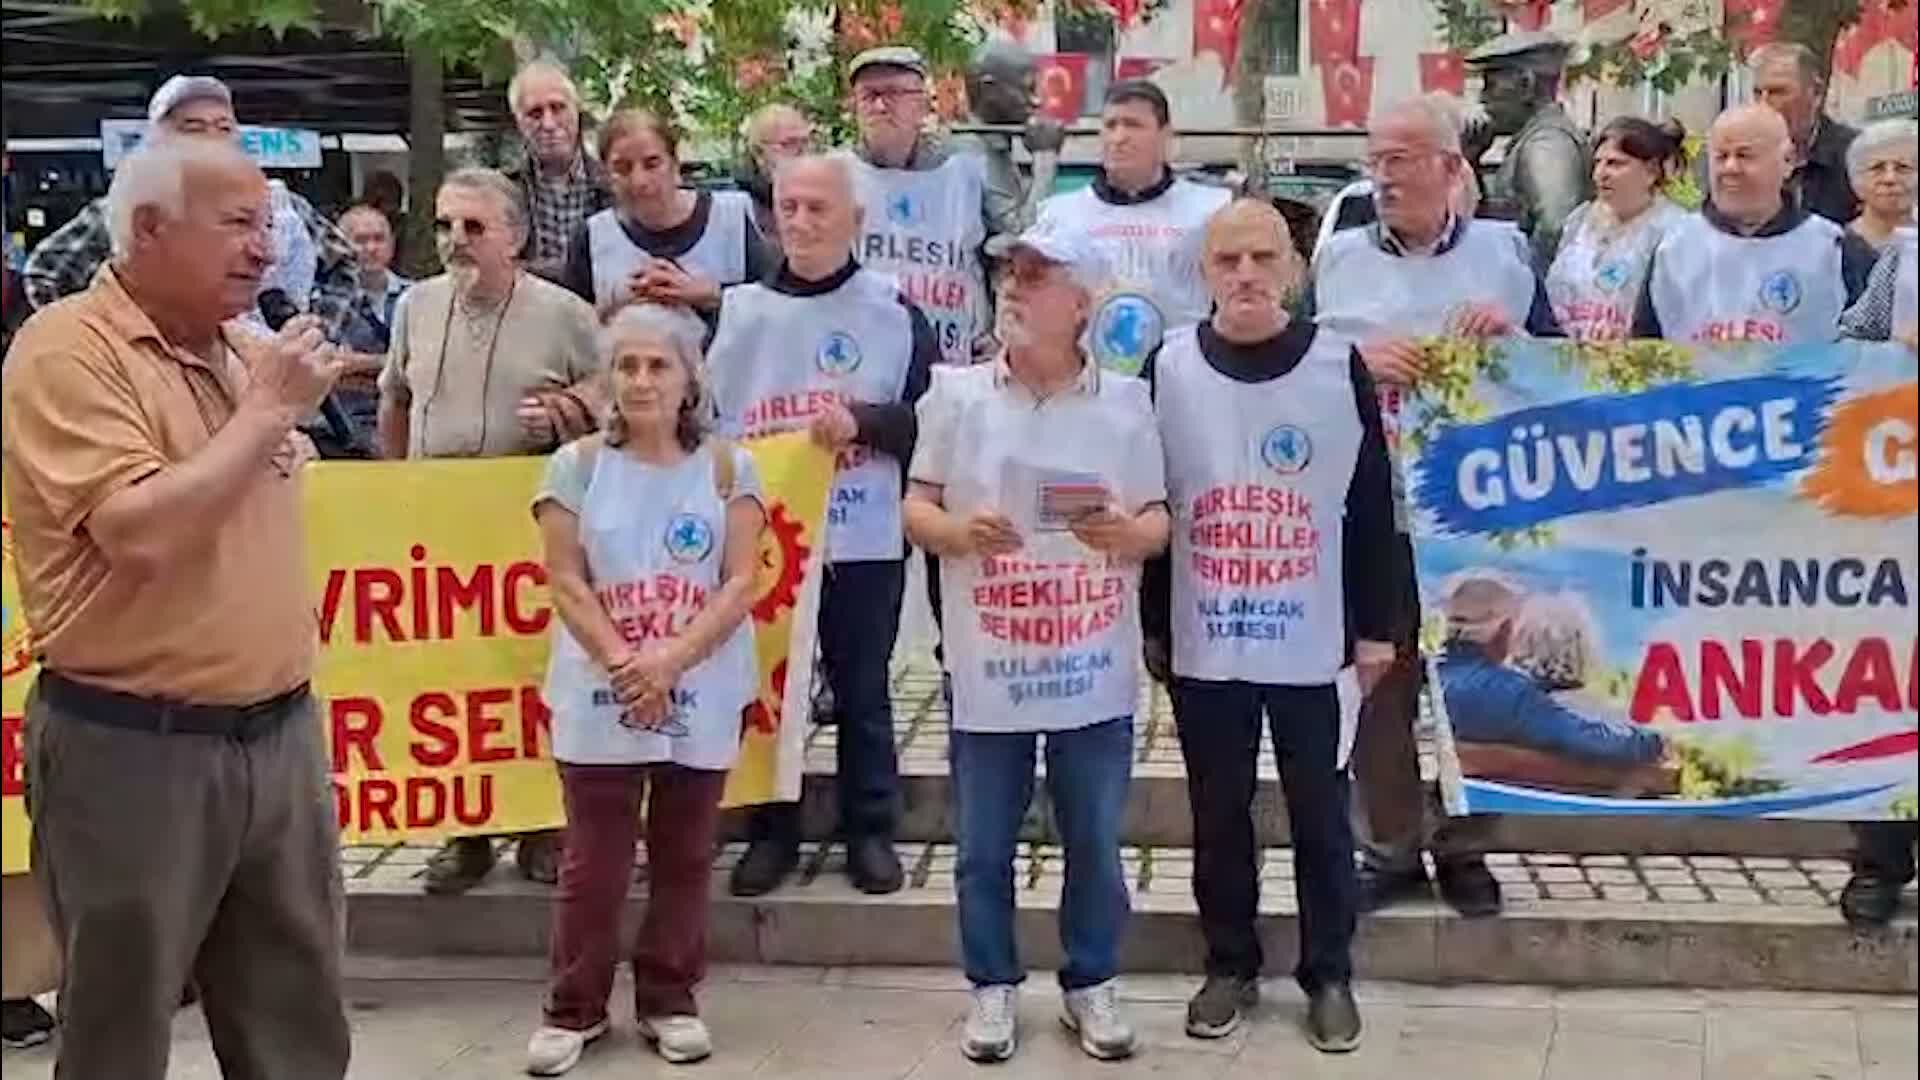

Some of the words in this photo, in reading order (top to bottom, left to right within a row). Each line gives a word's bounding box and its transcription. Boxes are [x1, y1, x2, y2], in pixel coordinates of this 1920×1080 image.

[1456, 397, 1802, 511] GÜVENCE
[1631, 547, 1909, 610] İNSANCA
[1628, 637, 1918, 725] ANKA
